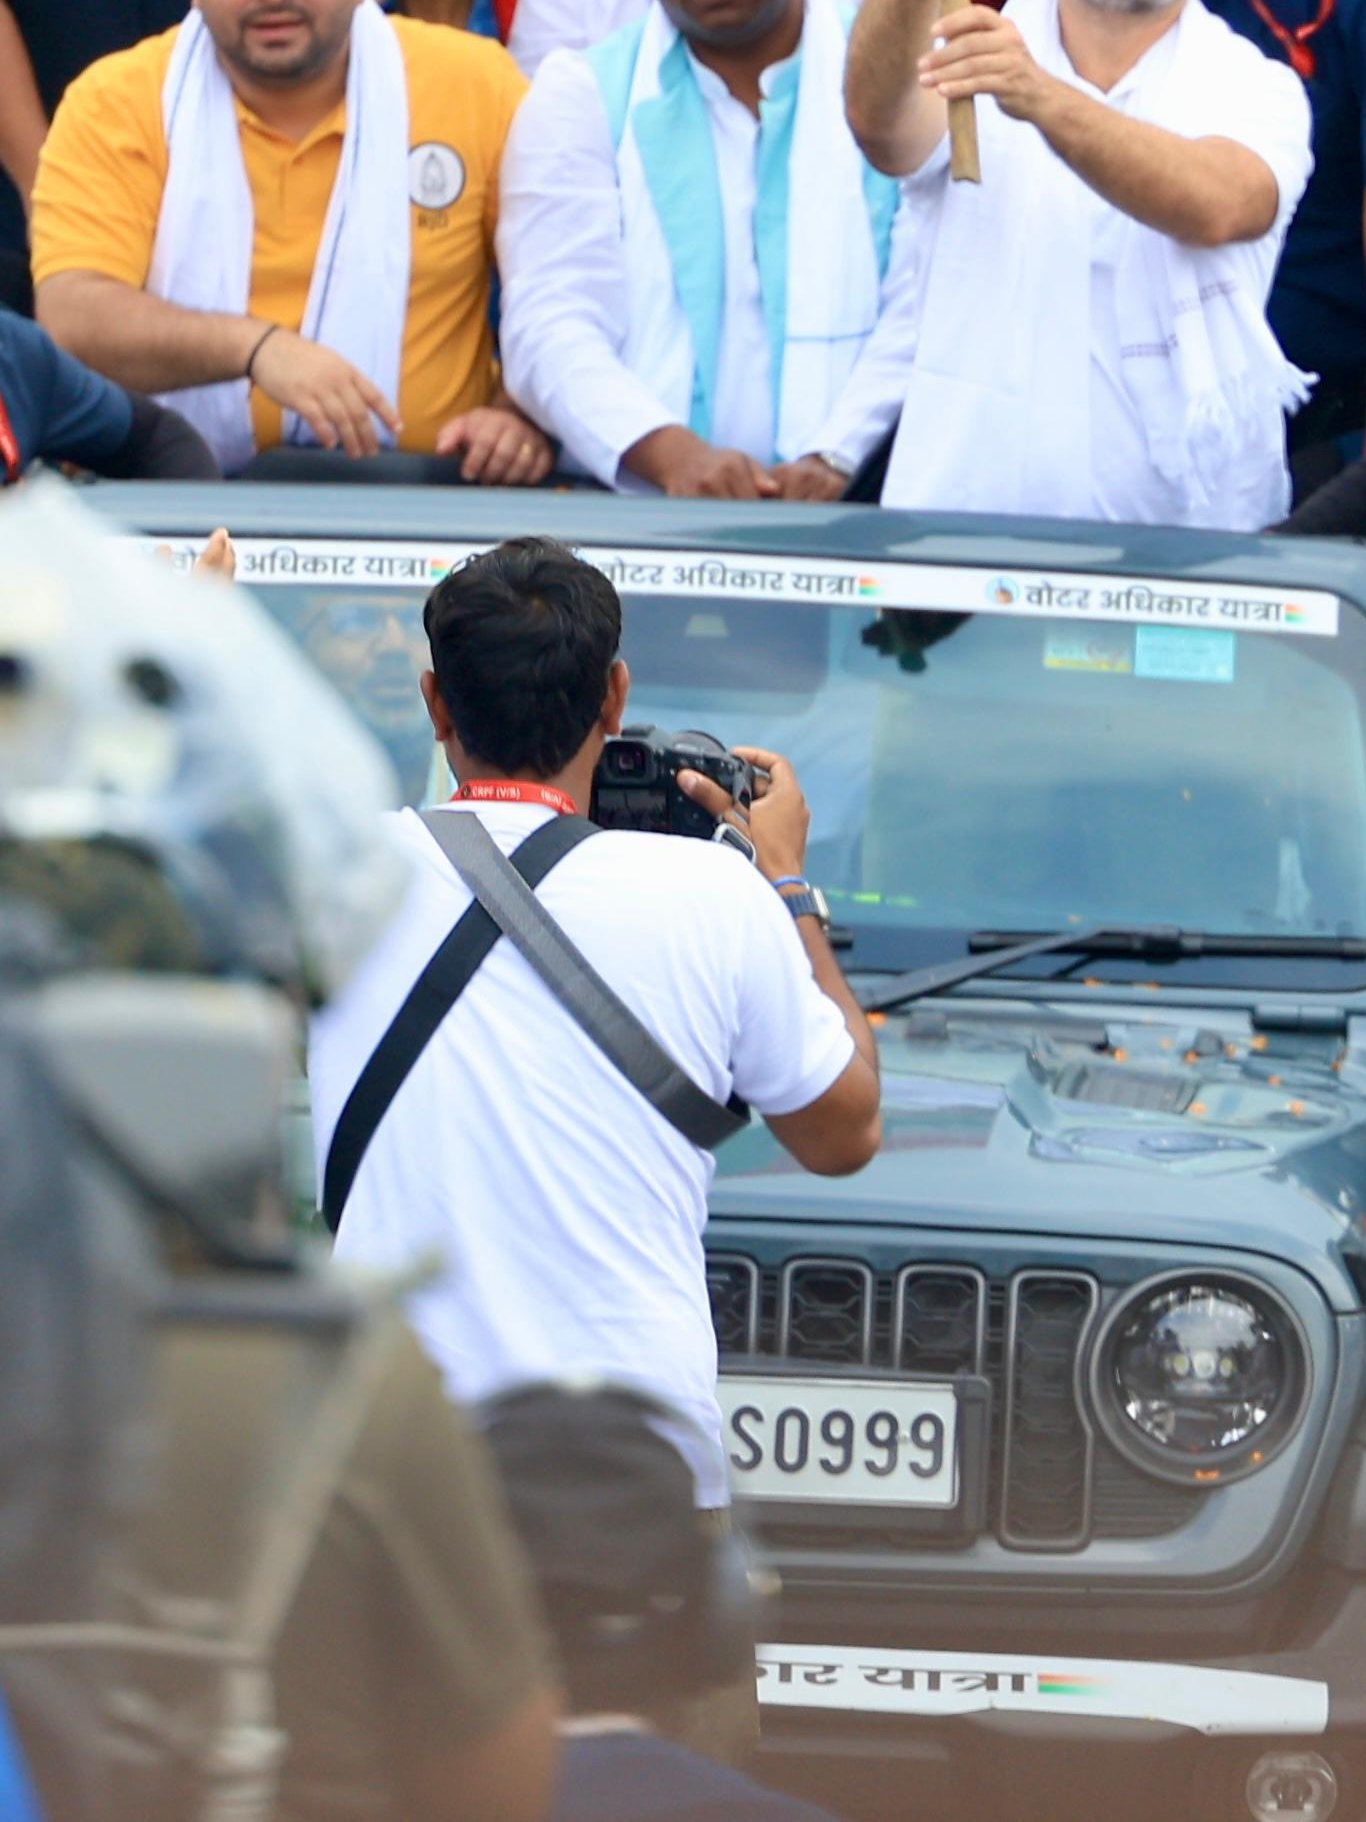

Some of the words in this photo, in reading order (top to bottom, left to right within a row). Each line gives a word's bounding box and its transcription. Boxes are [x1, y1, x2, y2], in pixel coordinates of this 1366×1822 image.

[244, 548, 355, 576] अधिकार
[363, 555, 428, 579] यात्रा
[674, 559, 784, 590] अधिकार
[792, 572, 856, 595] यात्रा
[1025, 580, 1091, 610] वोटर
[1101, 585, 1211, 617] अधिकार
[1219, 596, 1284, 622] यात्रा
[858, 1664, 1032, 1693] यात्रा
